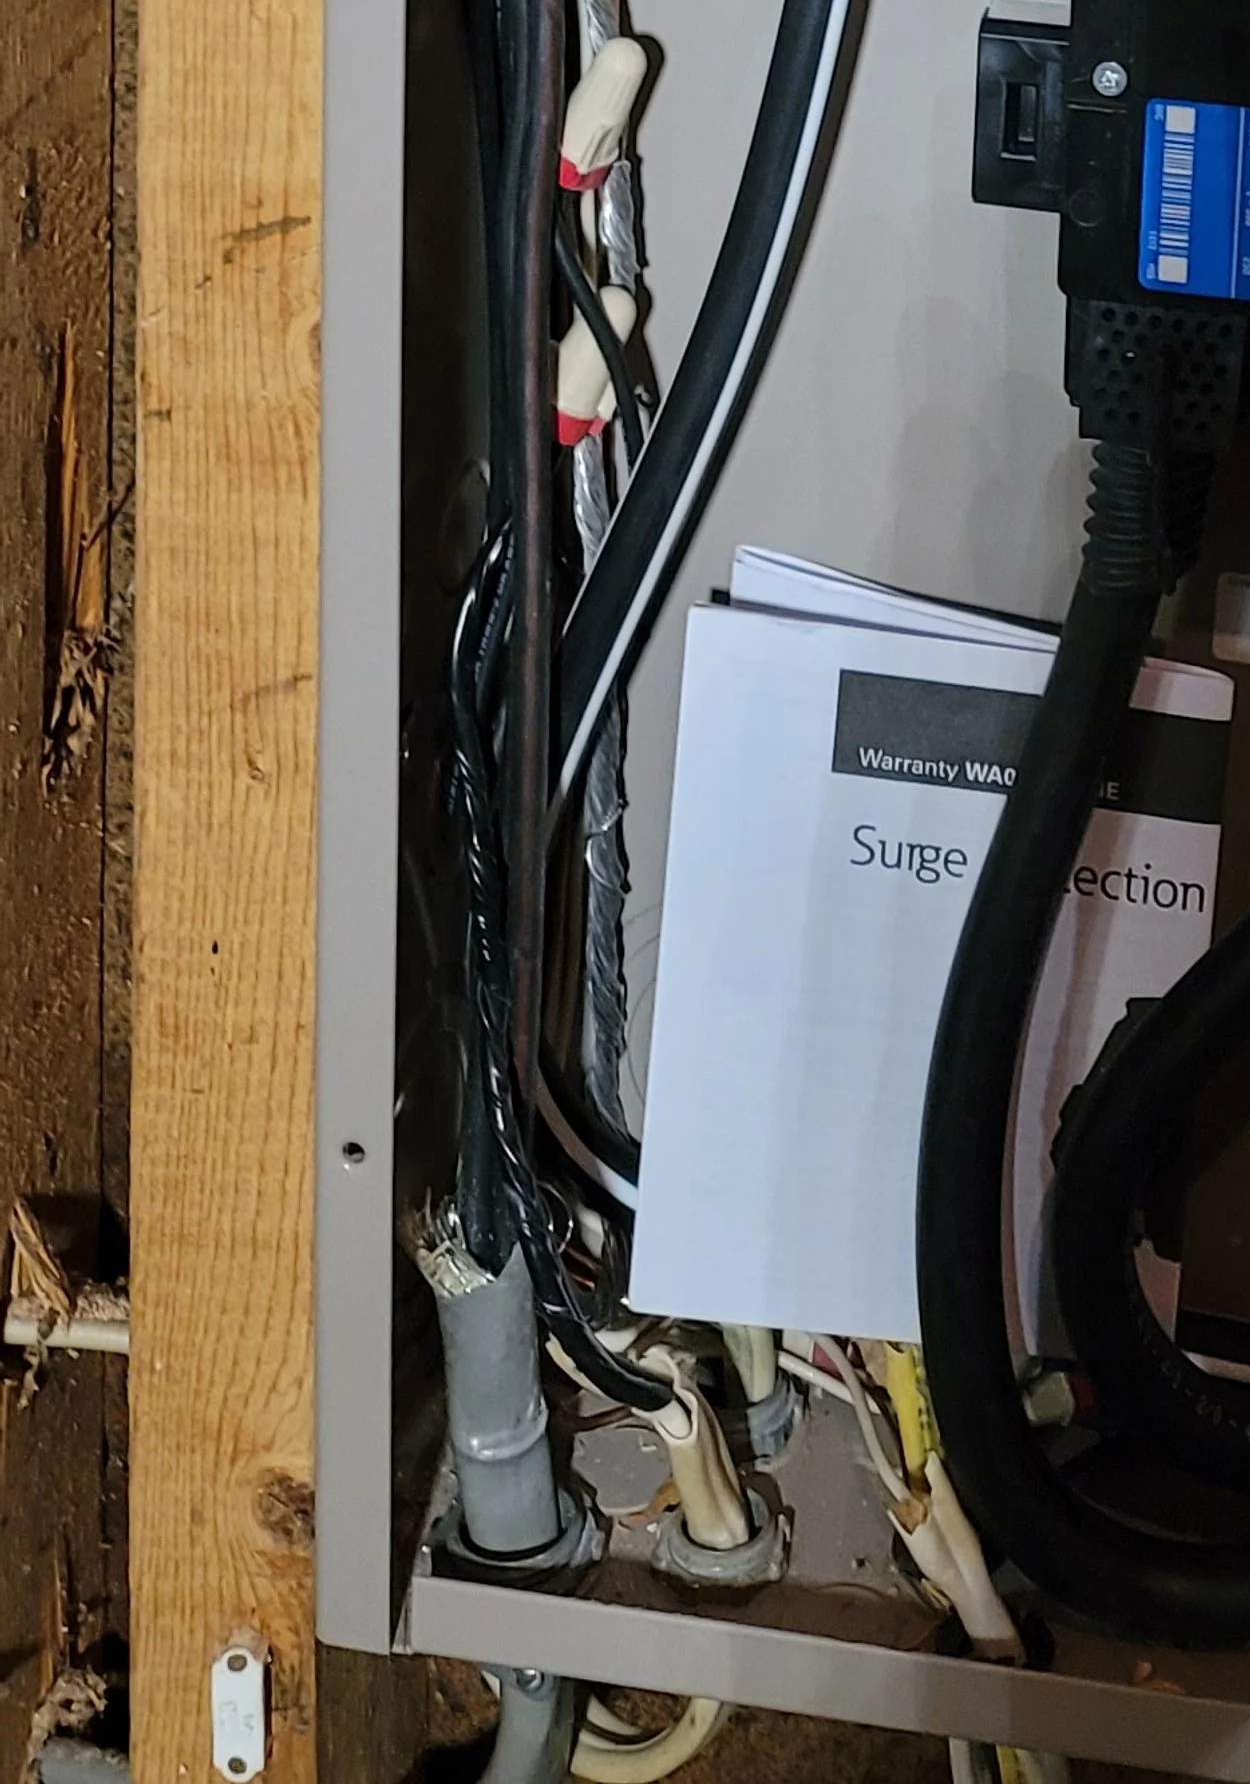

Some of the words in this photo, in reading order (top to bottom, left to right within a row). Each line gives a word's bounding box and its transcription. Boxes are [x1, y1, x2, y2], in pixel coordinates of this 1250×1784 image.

[859, 746, 959, 783] Warranty
[850, 824, 968, 884] Surge
[1064, 862, 1206, 914] ection
